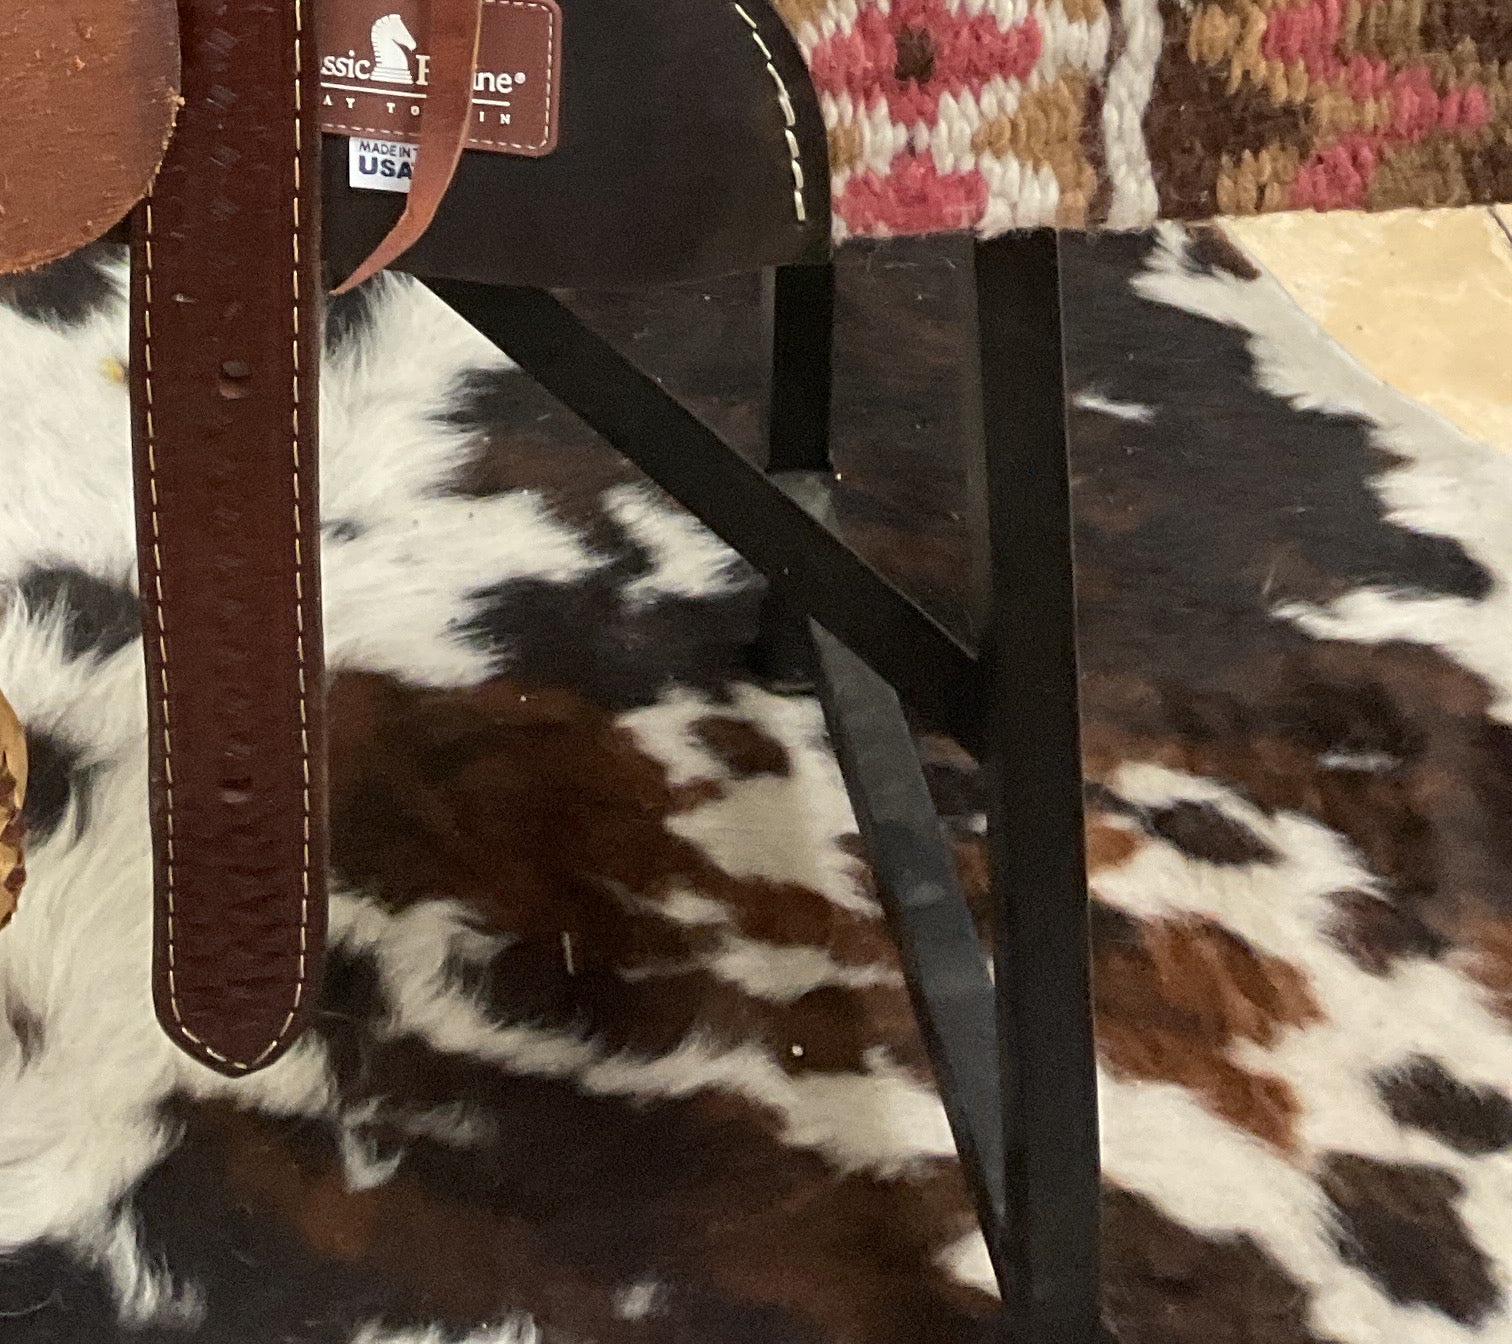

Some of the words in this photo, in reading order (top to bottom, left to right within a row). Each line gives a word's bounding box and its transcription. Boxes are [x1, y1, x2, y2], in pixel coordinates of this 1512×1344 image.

[322, 94, 356, 110] AY
[386, 102, 421, 117] TO
[478, 111, 512, 126] IN
[358, 139, 398, 158] MADE
[398, 143, 411, 159] IN
[358, 155, 414, 180] USA
